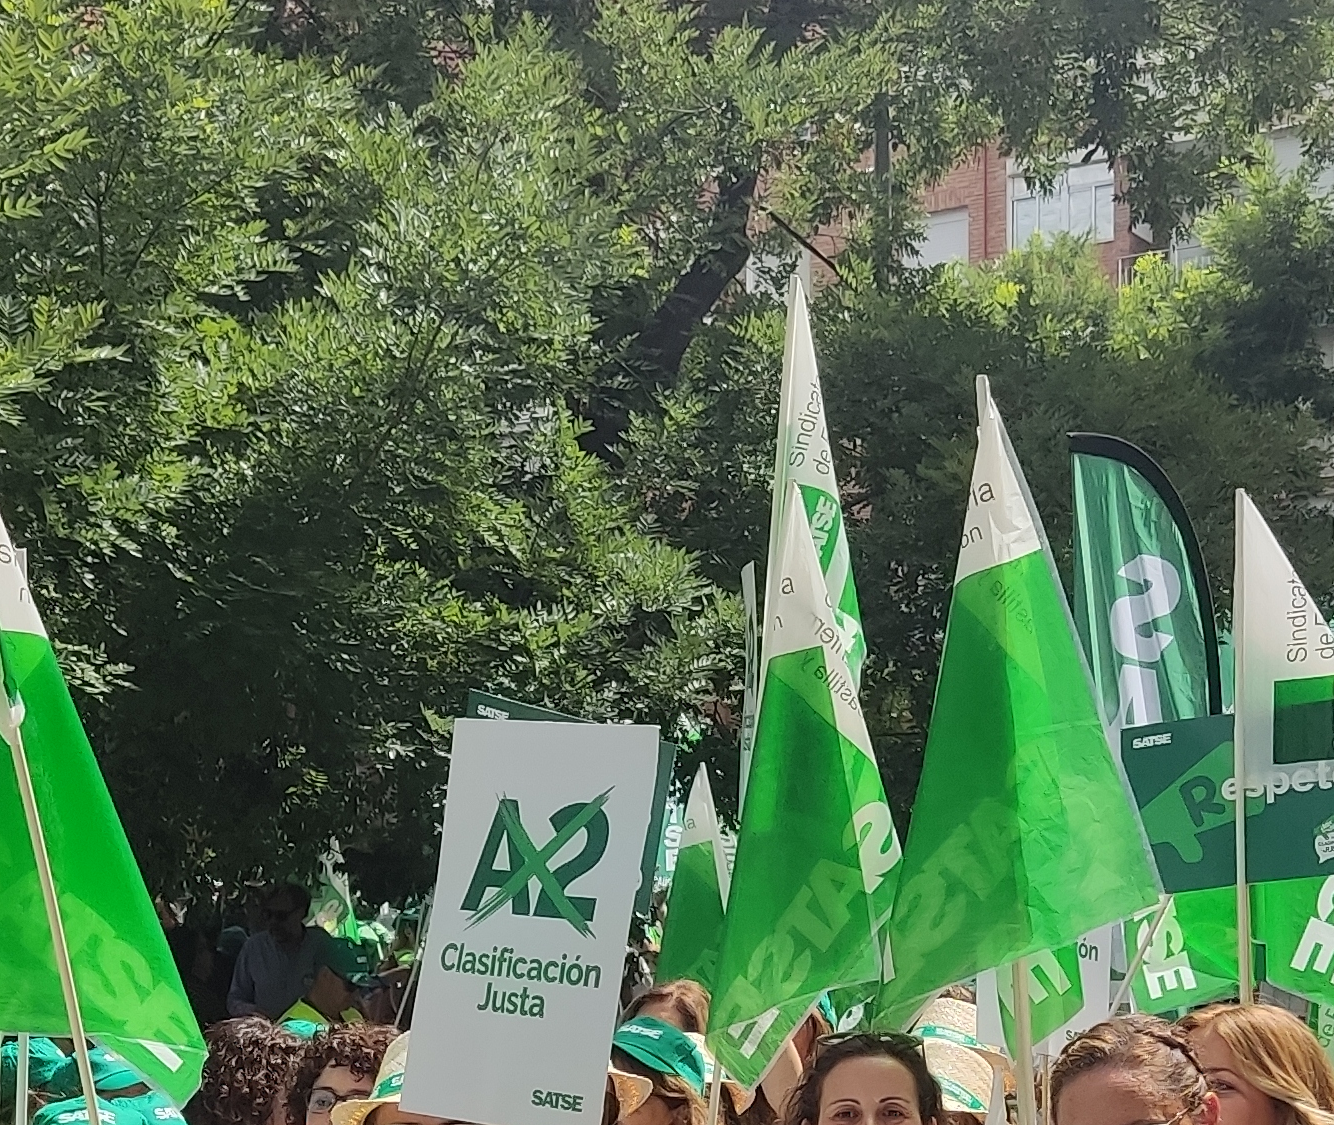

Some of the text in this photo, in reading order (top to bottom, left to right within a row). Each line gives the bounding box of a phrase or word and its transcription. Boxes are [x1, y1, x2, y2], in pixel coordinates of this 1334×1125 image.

[1132, 732, 1172, 749] SATSE
[460, 798, 609, 922] A2
[440, 942, 601, 989] Clasificación
[477, 982, 545, 1018] Justa
[531, 1089, 584, 1112] SATSE
